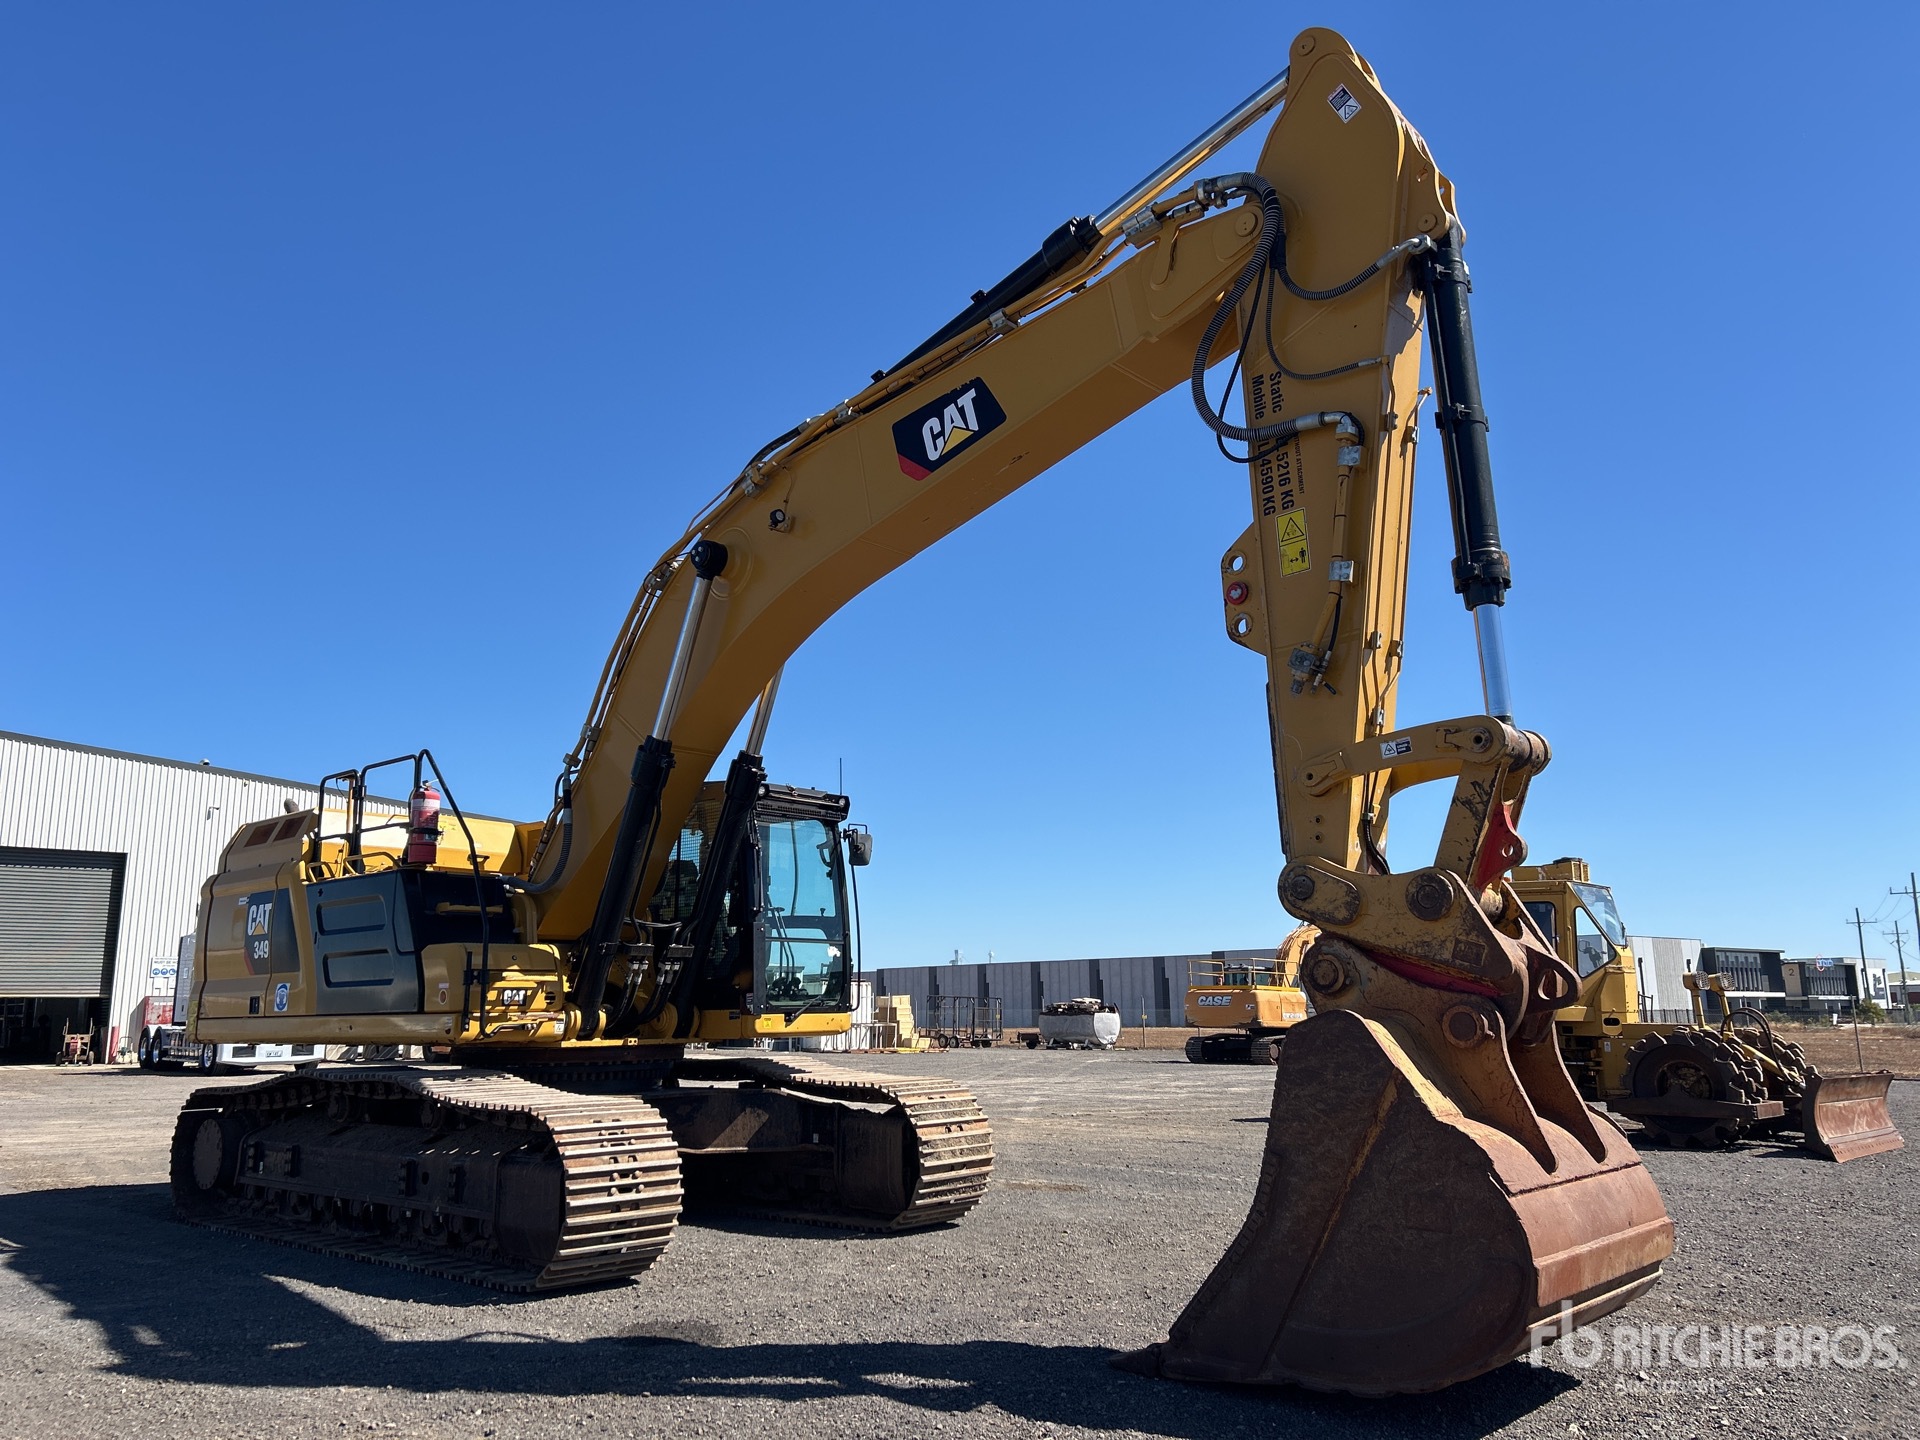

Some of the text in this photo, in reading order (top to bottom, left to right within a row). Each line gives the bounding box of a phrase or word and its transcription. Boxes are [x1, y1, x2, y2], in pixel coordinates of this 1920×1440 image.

[1252, 374, 1266, 420] Mobile
[1270, 371, 1284, 413] Static
[922, 388, 979, 461] CAT
[1260, 458, 1274, 495] 4590
[1276, 452, 1291, 487] 5216
[1263, 495, 1276, 516] KG
[1281, 489, 1294, 510] KG
[247, 903, 273, 936] CAT
[254, 940, 269, 959] 349
[1788, 968, 1795, 976] 2
[503, 989, 526, 1005] CAT
[1197, 996, 1232, 1006] CASE
